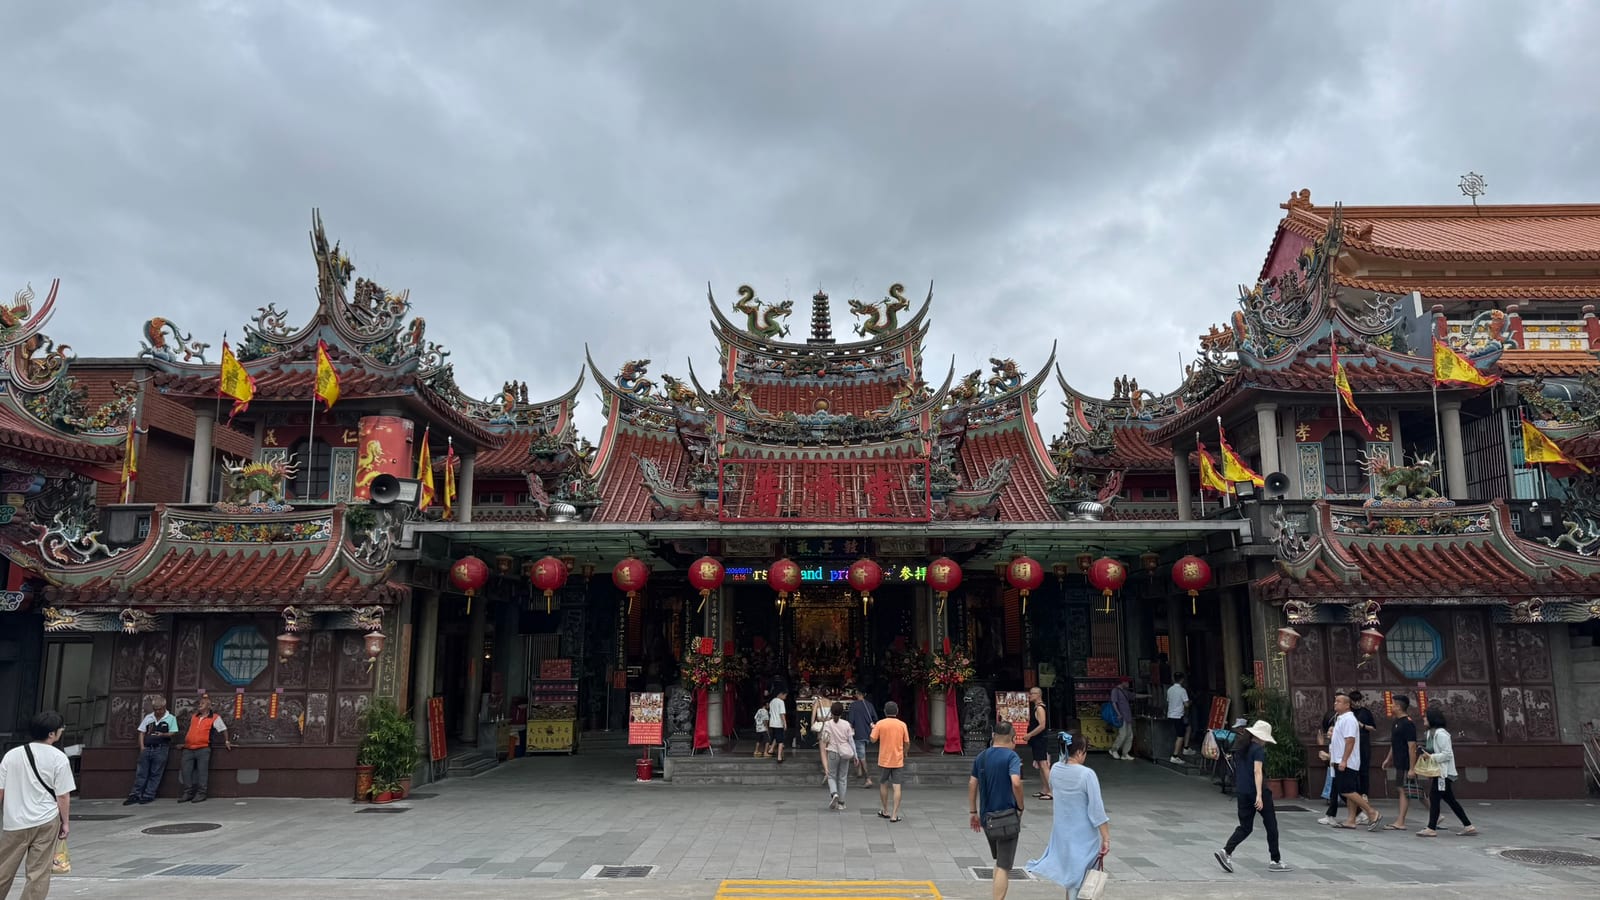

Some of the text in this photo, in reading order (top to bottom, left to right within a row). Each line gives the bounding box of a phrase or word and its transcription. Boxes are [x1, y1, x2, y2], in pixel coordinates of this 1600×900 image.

[264, 429, 278, 446] 義
[341, 429, 358, 444] 仁
[1296, 422, 1312, 442] 孝
[1376, 423, 1390, 442] 忠
